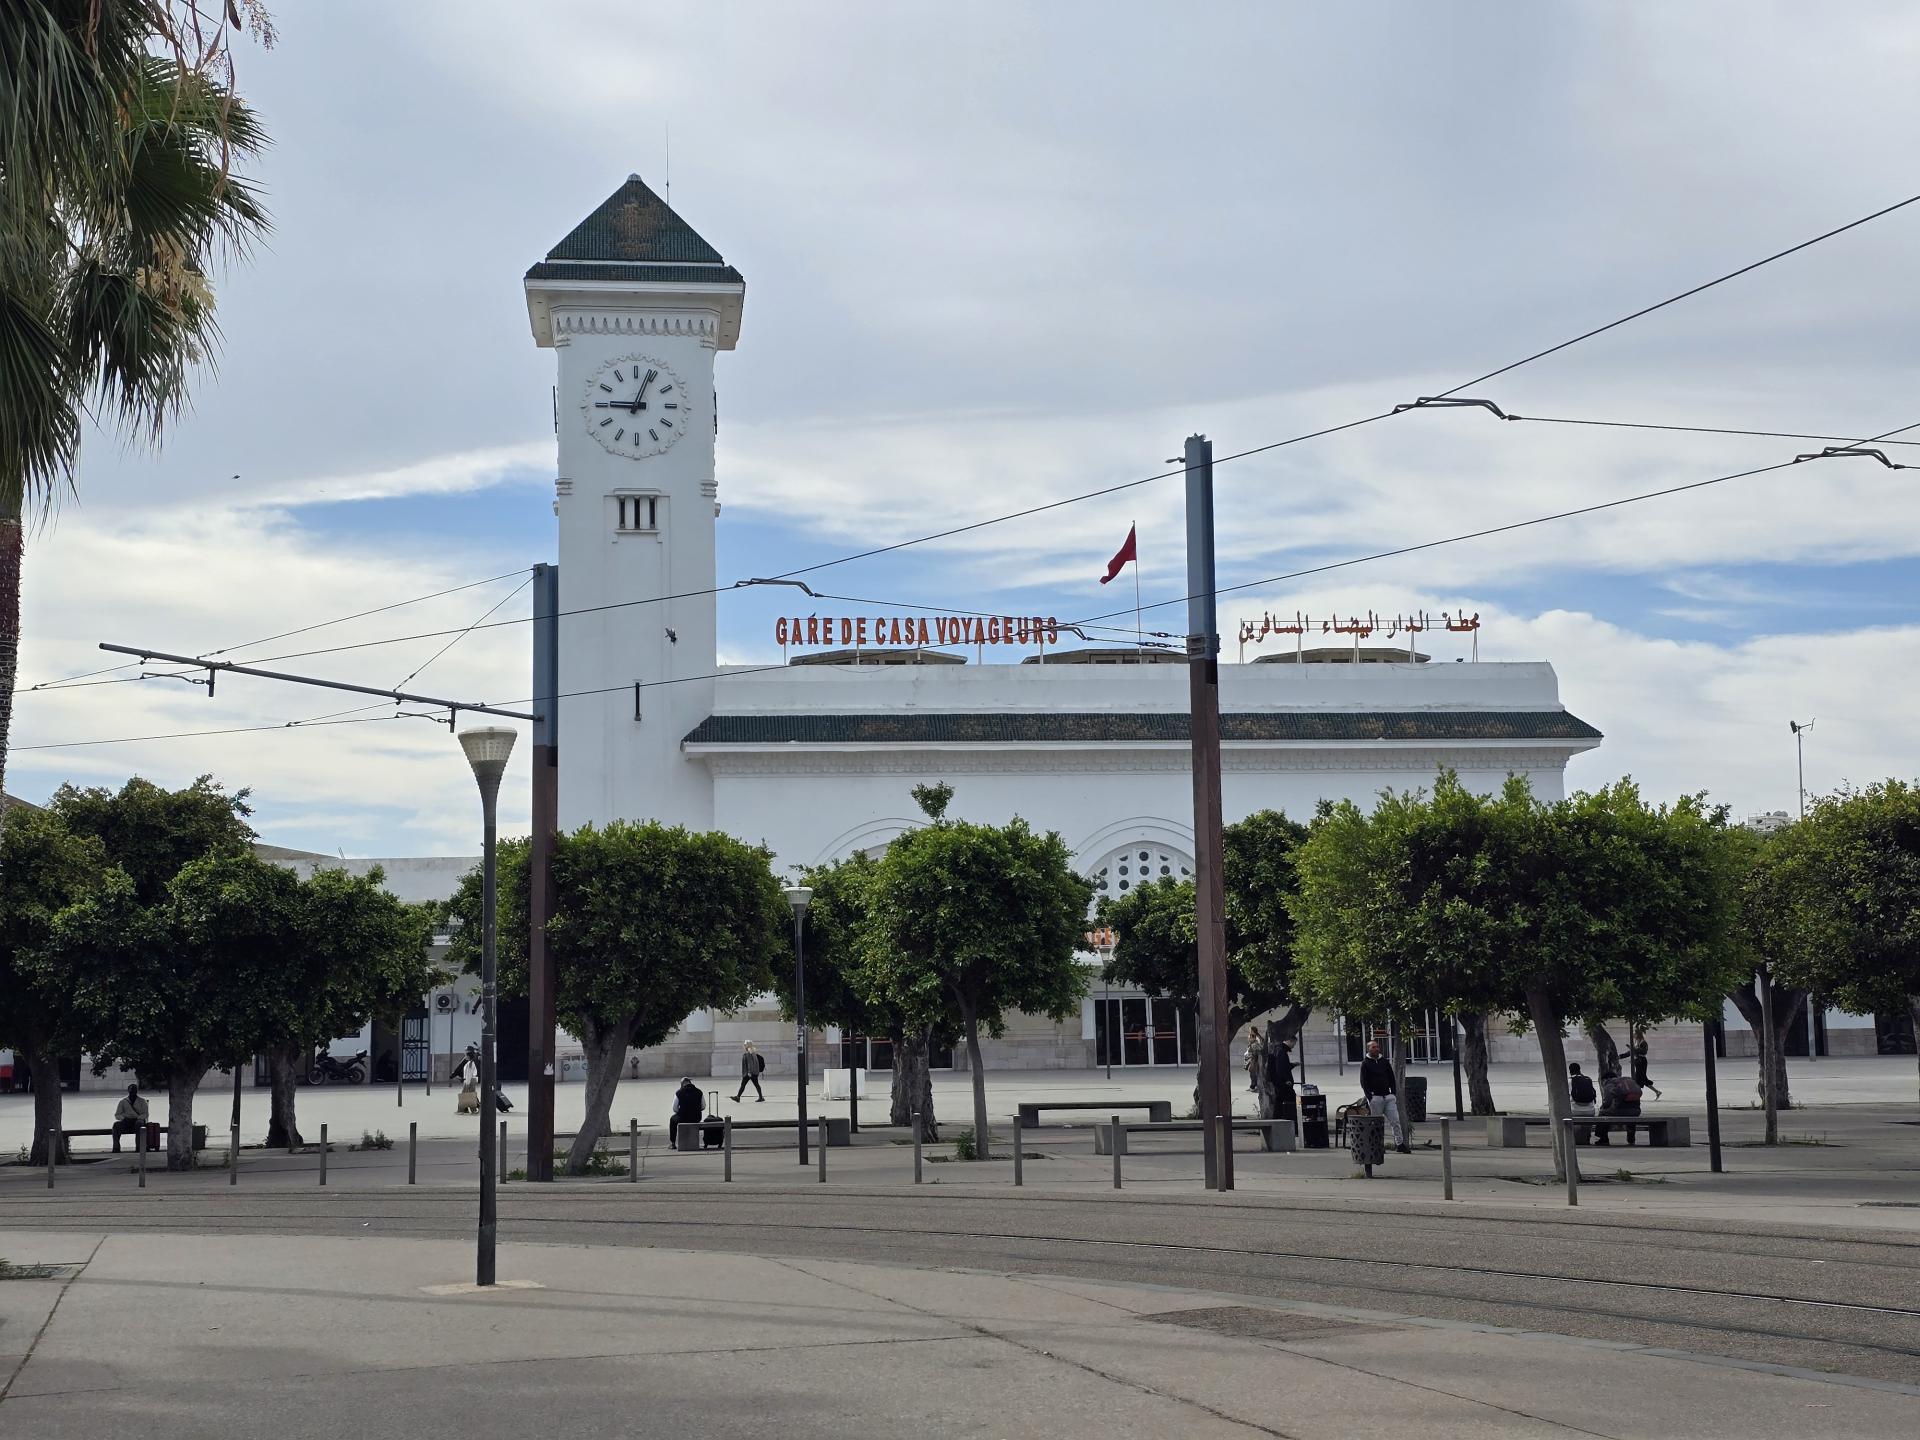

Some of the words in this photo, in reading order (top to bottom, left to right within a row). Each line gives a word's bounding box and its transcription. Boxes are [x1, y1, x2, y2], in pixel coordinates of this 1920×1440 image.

[775, 617, 833, 646] GARE
[841, 617, 867, 645] DE
[875, 617, 930, 645] CASA
[935, 616, 1058, 645] VOYAGEURS
[1239, 610, 1310, 643] المسافرين
[1322, 609, 1379, 639] البيضاء
[1386, 609, 1430, 639] الدار
[1441, 608, 1481, 632] محطة
